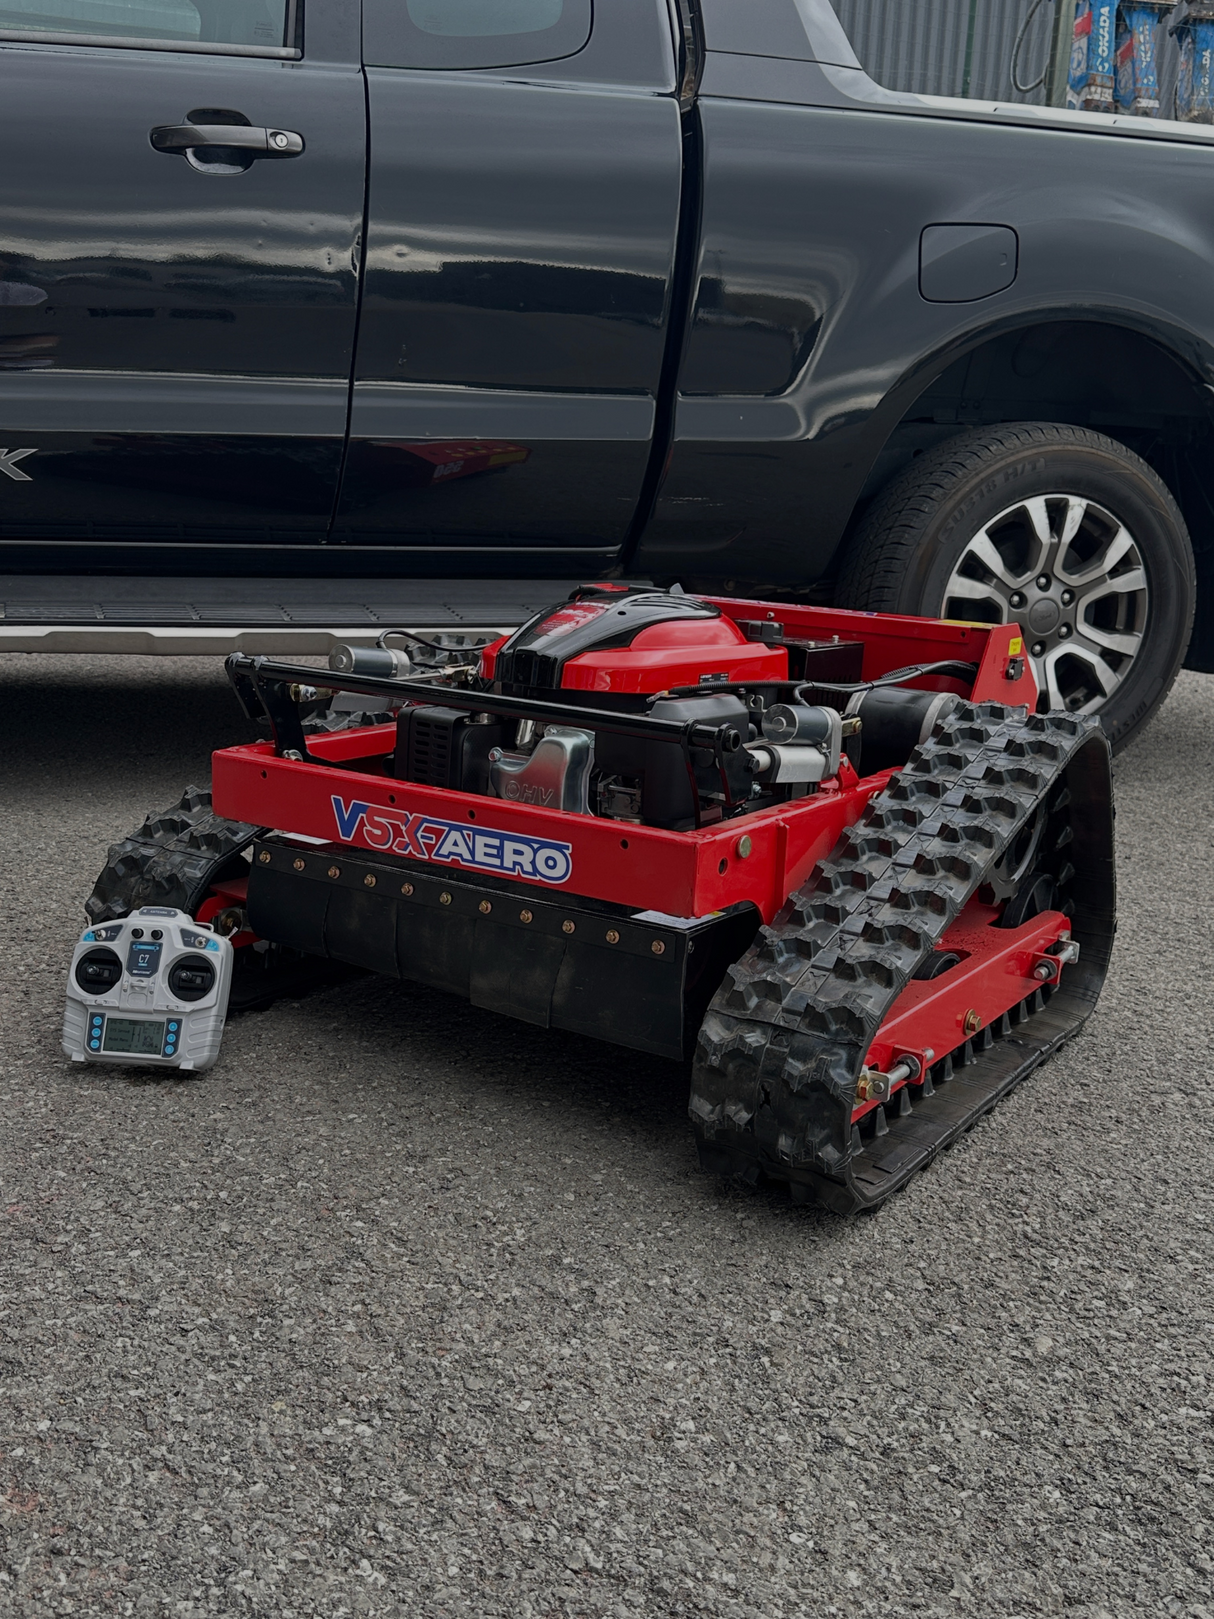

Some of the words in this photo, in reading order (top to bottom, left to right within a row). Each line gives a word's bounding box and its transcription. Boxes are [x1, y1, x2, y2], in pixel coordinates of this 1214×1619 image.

[1098, 6, 1110, 57] OKADA
[505, 780, 554, 806] OHV
[138, 953, 150, 964] C7
